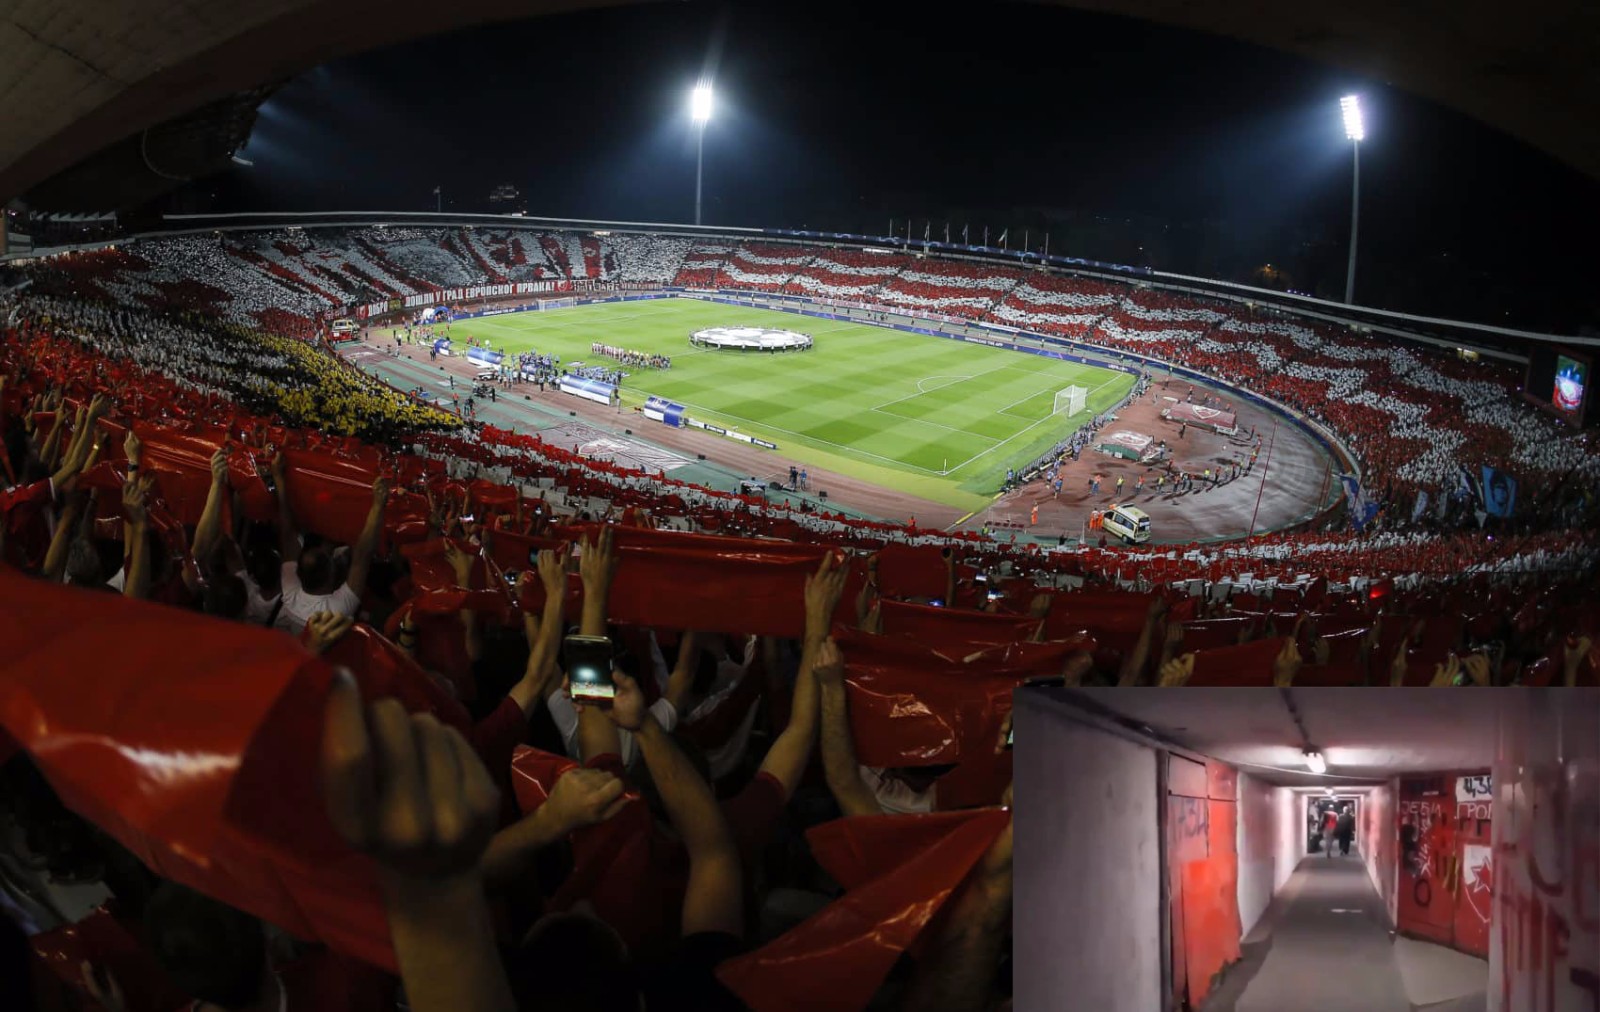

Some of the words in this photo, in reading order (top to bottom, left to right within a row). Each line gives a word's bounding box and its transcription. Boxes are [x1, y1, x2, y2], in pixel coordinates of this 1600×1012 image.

[435, 290, 440, 302] У
[442, 288, 463, 301] ГРАД
[466, 284, 514, 299] ЕВРОПСКОГ
[517, 281, 555, 293] ПРВАКА!
